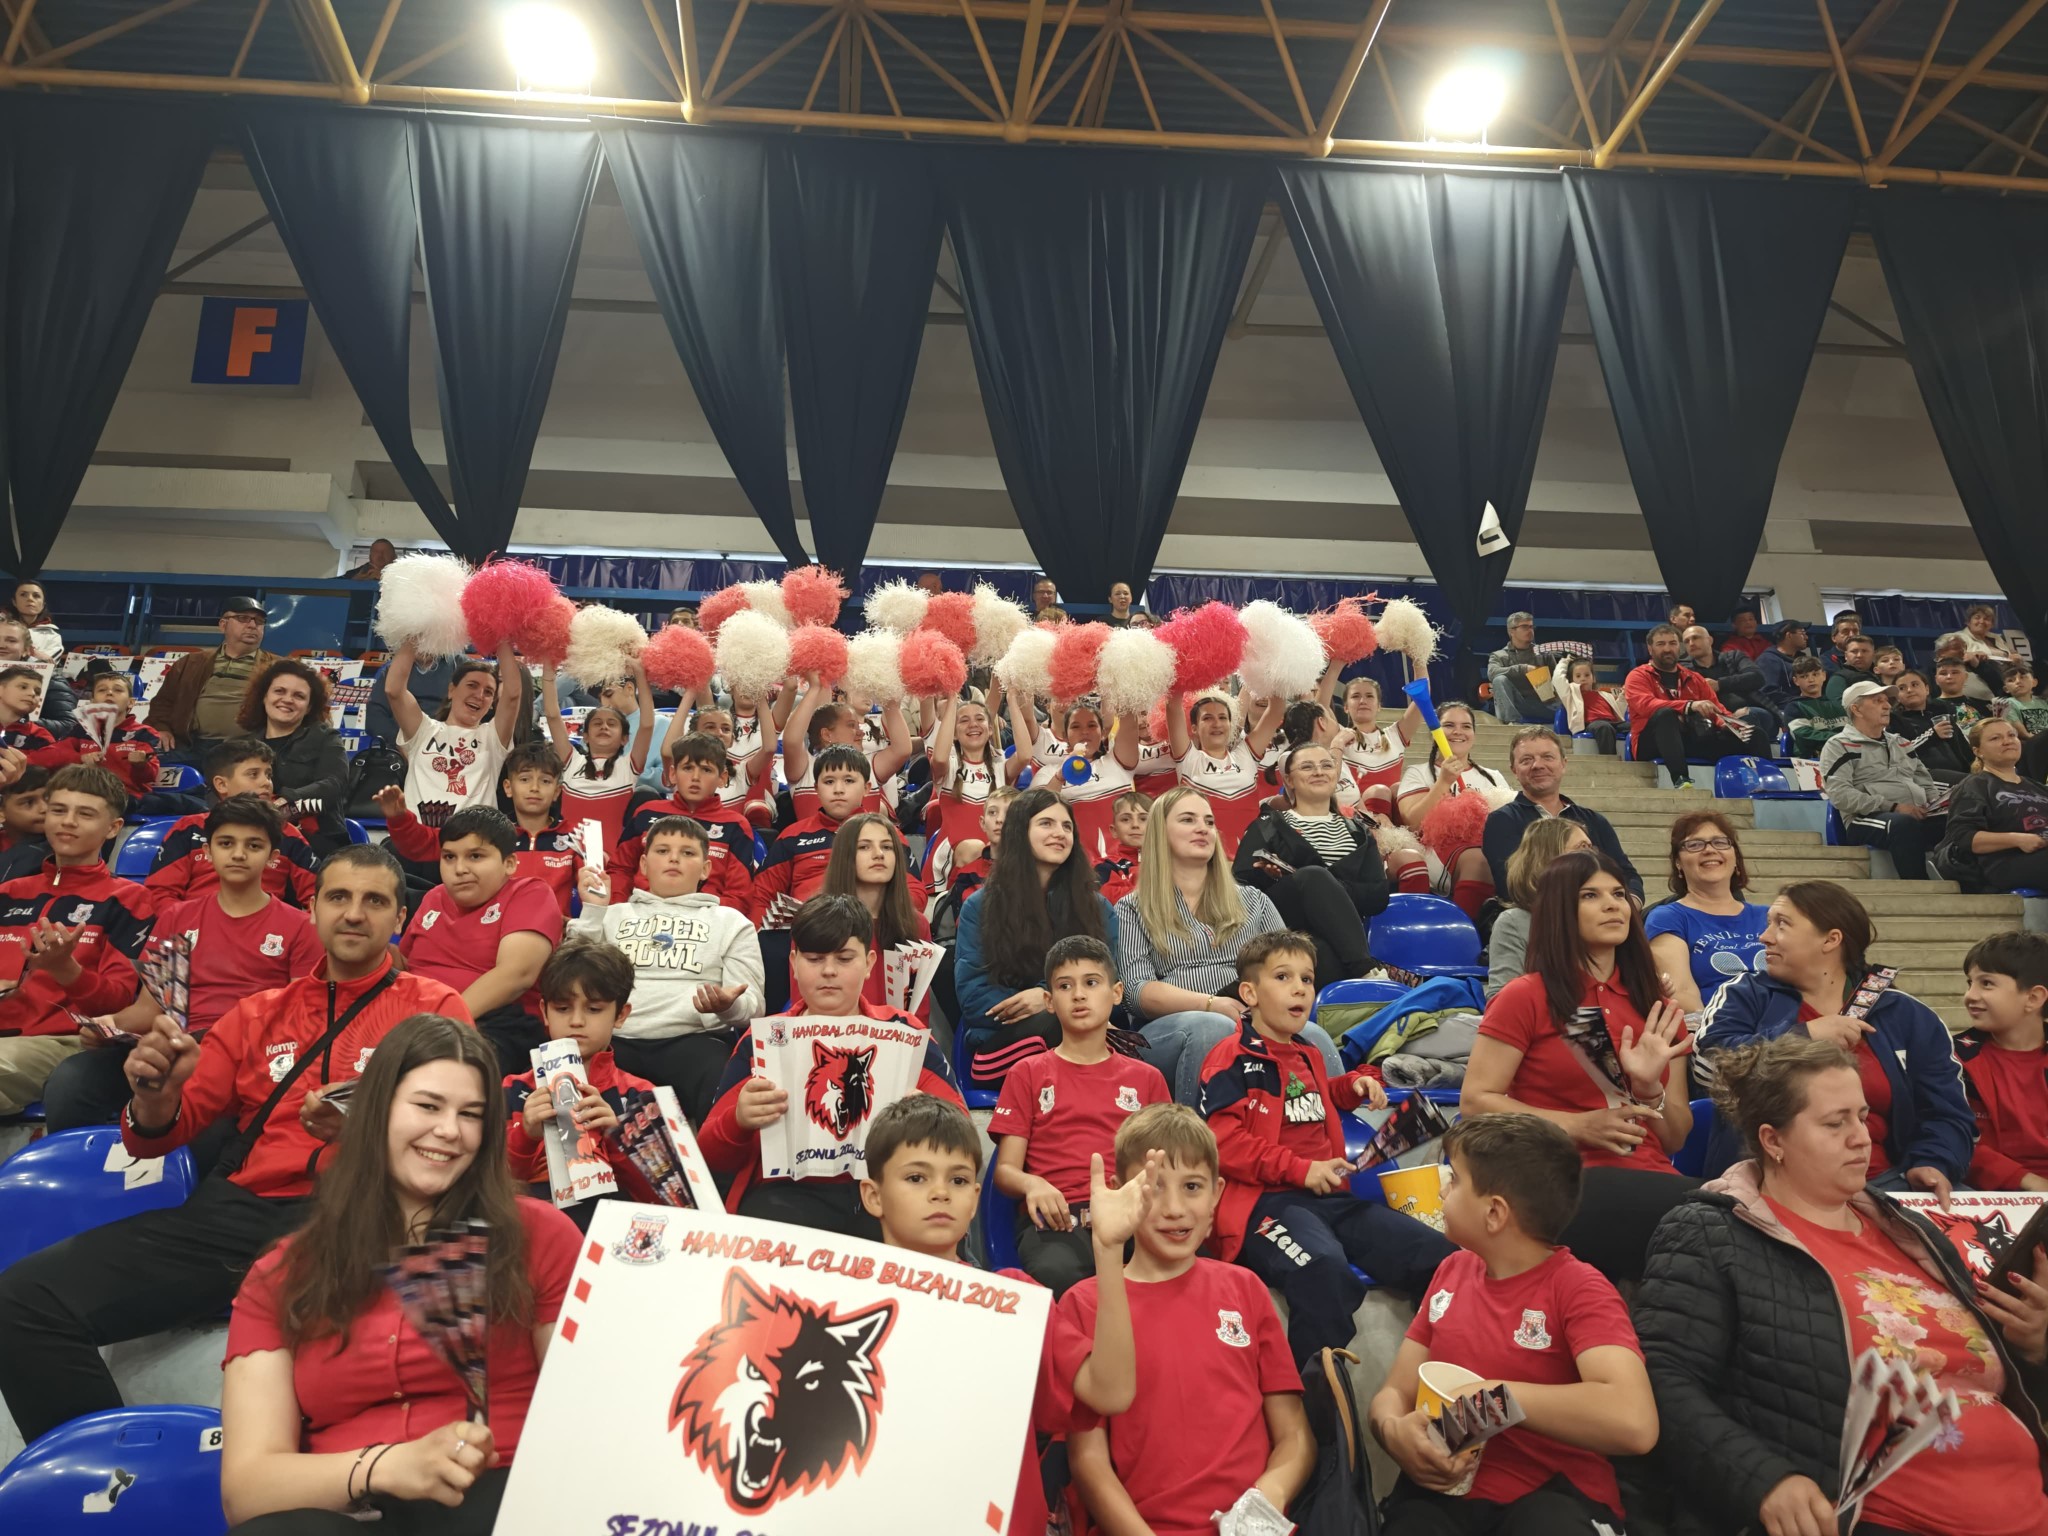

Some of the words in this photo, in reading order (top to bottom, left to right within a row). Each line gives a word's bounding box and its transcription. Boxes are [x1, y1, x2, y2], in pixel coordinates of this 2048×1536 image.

[226, 307, 278, 377] F
[797, 836, 826, 846] Zeus
[616, 914, 711, 943] SUPER
[618, 939, 703, 975] BOWL
[265, 1041, 298, 1057] Kemp
[792, 1024, 845, 1039] HANDBAL
[846, 1024, 869, 1038] CLUB
[869, 1026, 904, 1043] BUZAU
[905, 1033, 923, 1048] 2012
[796, 1147, 839, 1165] SEZONUL
[1983, 1196, 2020, 1207] BUZAU
[1265, 1224, 1312, 1267] Zeus
[681, 1230, 804, 1267] HANDBAL
[806, 1248, 876, 1280] CLUB
[877, 1261, 961, 1302] BUZAU
[963, 1282, 1021, 1315] 2012
